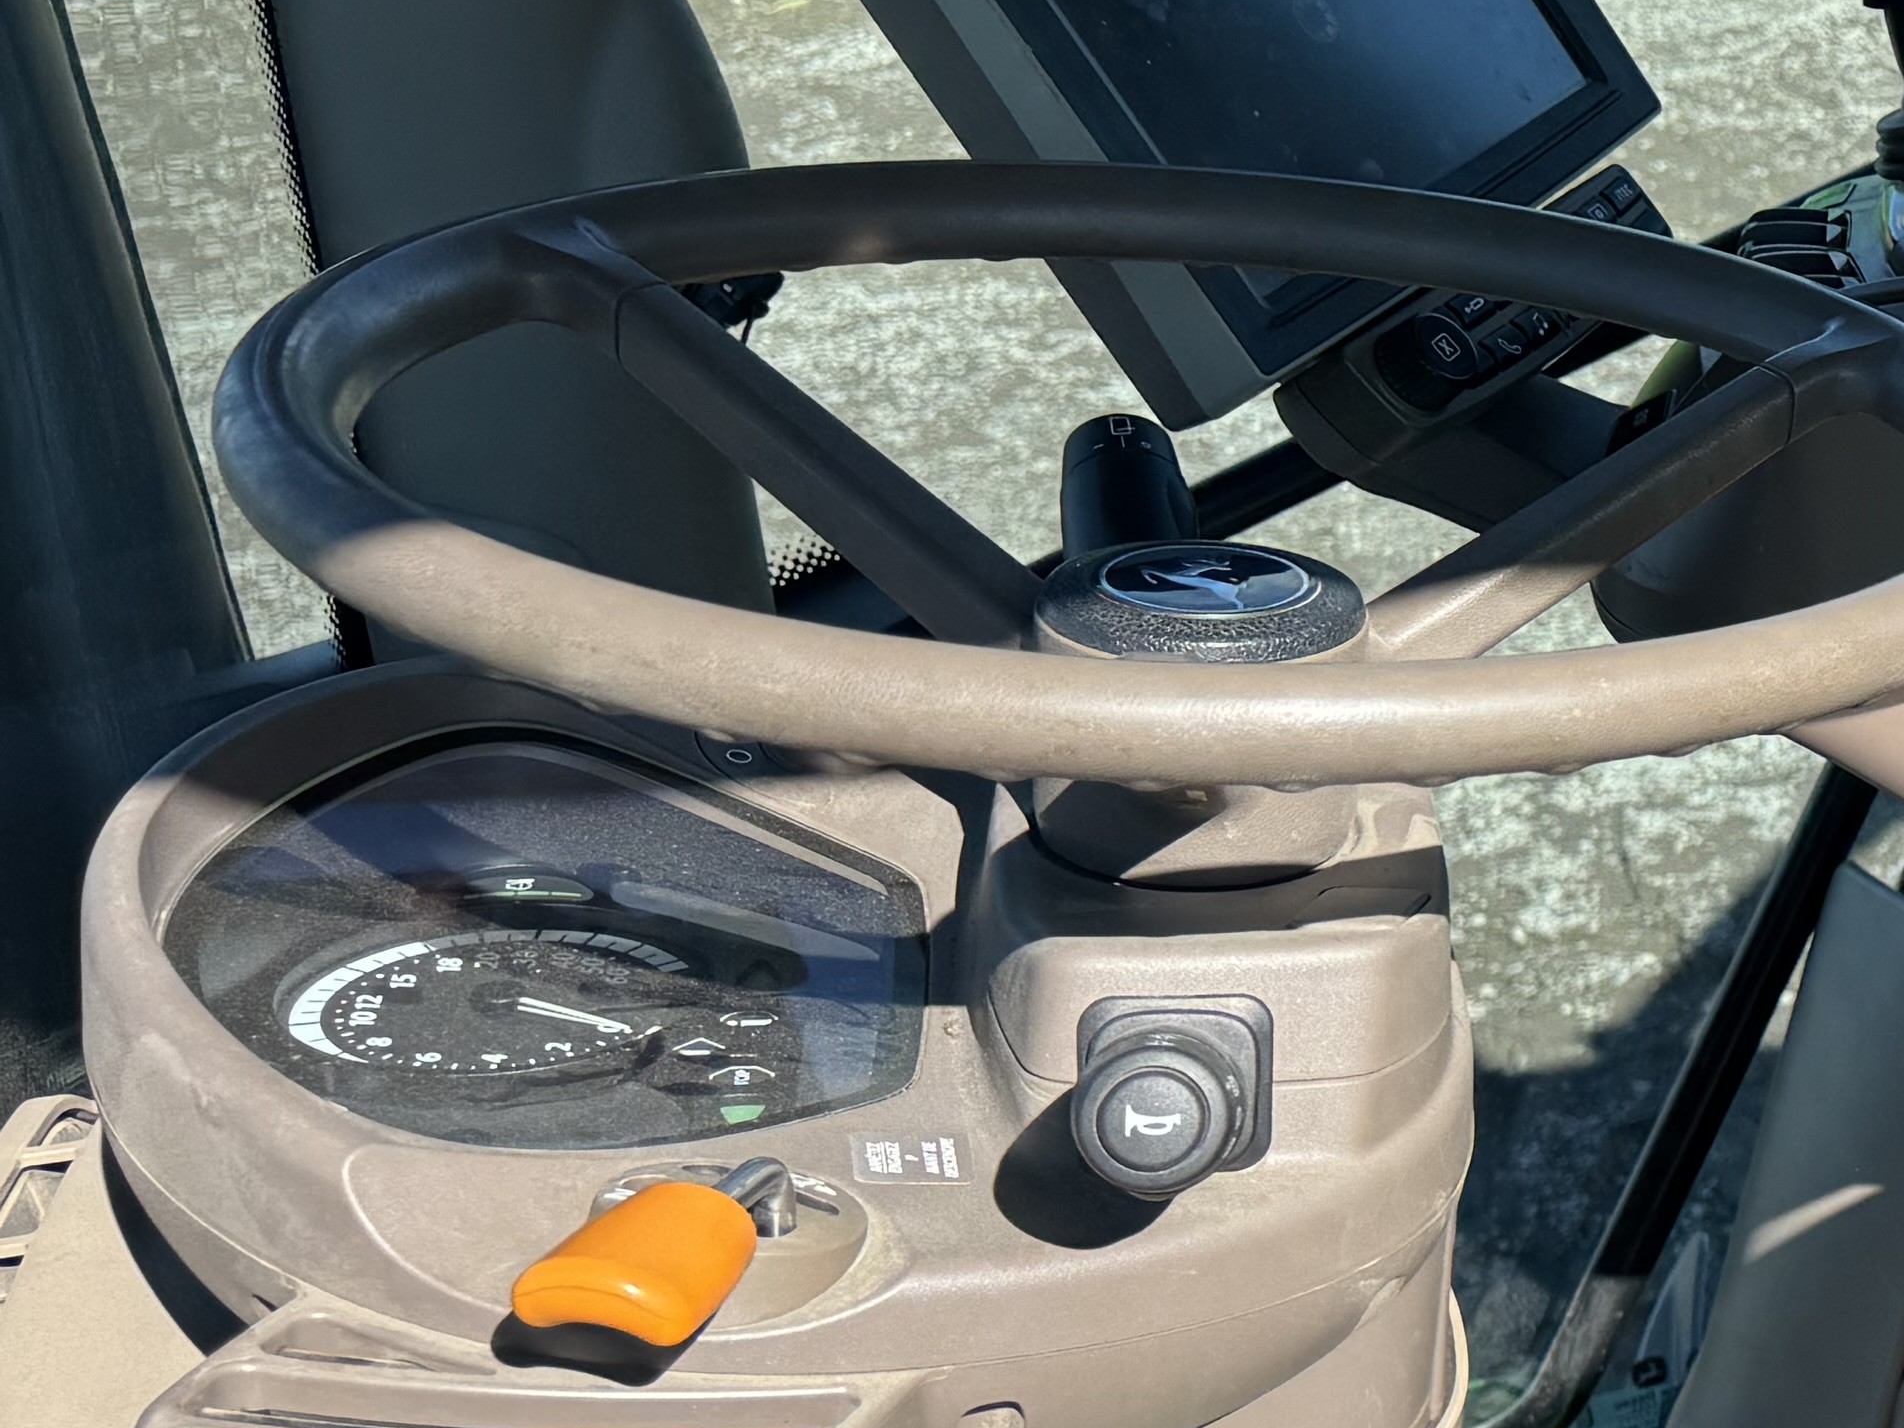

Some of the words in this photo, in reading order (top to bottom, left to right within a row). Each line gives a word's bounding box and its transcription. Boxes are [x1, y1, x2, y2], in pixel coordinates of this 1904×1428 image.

[435, 957, 463, 973] 18
[389, 973, 417, 989] 15
[354, 994, 383, 1010] 12
[349, 1011, 377, 1026] 10
[365, 1036, 393, 1048] 8
[545, 1041, 572, 1054] 2
[415, 1052, 442, 1064] 6
[480, 1053, 508, 1069] 4
